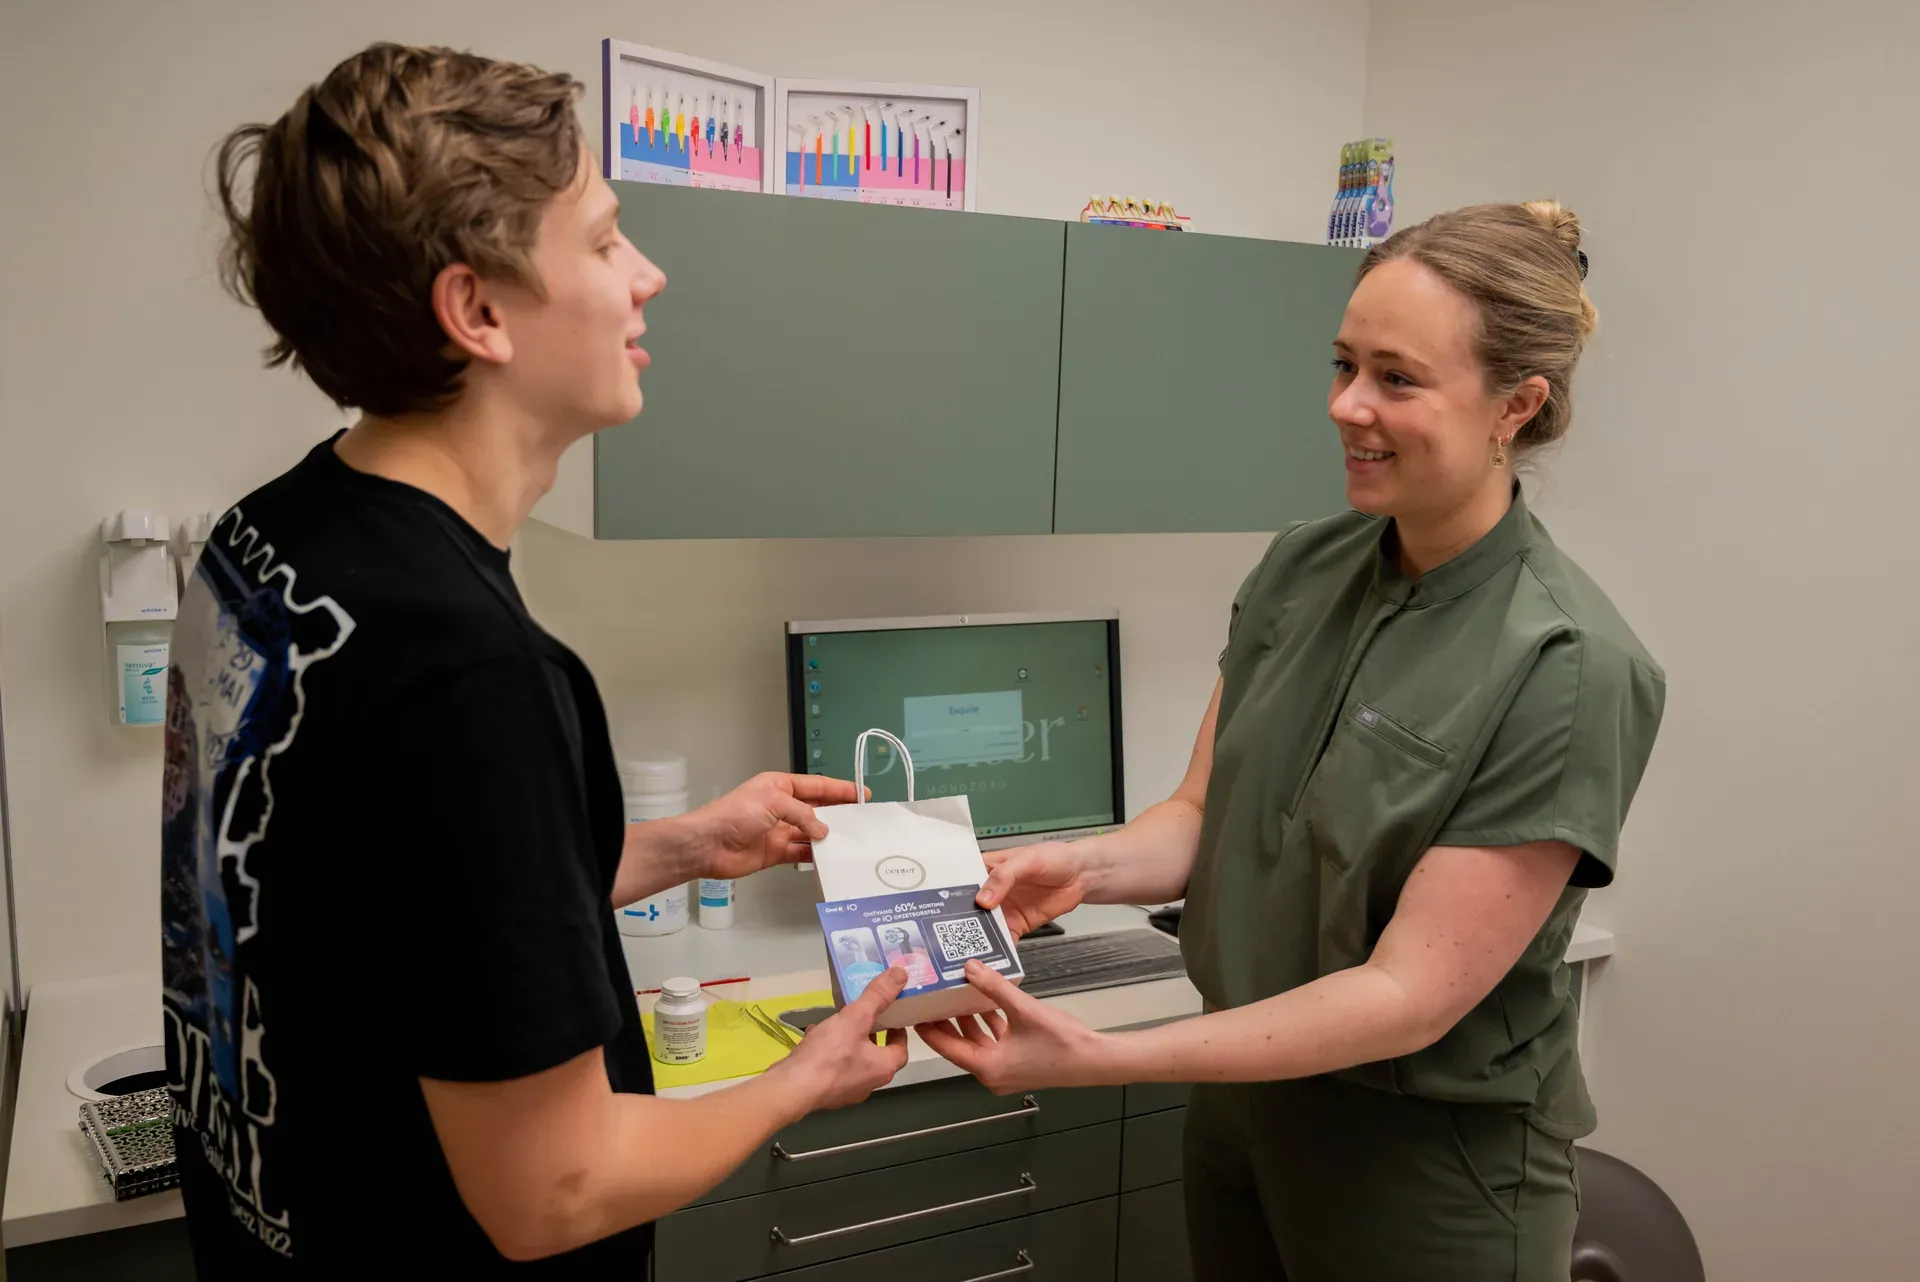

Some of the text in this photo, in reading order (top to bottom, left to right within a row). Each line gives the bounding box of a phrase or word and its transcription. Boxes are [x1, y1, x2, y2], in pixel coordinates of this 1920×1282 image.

[863, 901, 945, 917] ONTVANG 60% KORTING
